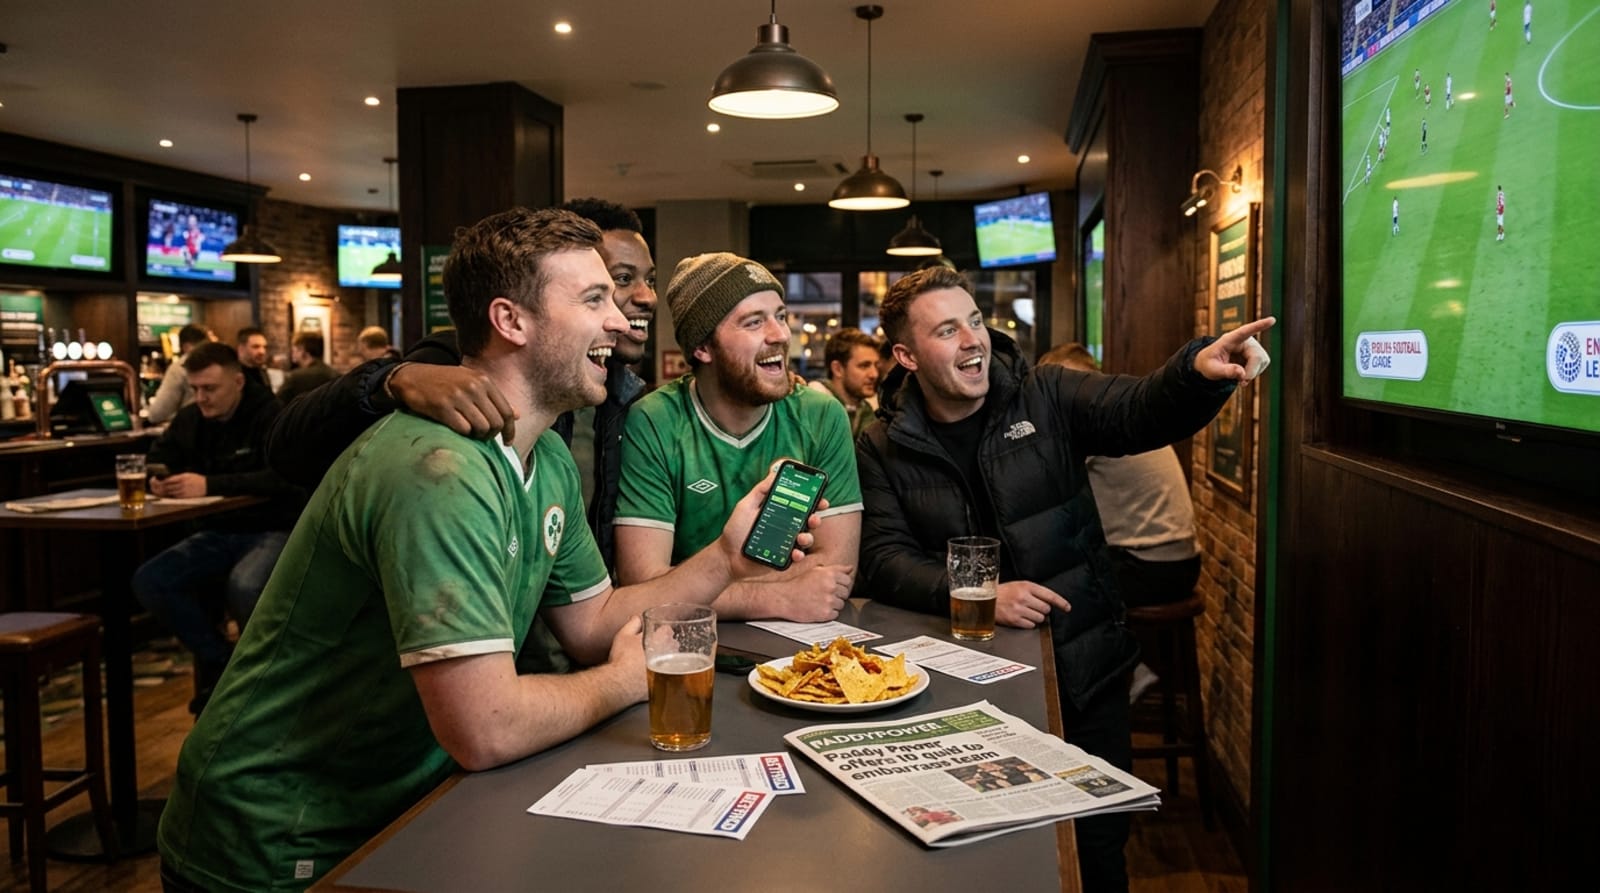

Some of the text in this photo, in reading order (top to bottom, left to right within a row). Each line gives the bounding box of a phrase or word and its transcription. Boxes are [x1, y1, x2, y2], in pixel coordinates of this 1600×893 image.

[1586, 360, 1600, 378] LE
[823, 747, 884, 763] Paddy
[839, 756, 896, 772] offers
[921, 745, 963, 761] quid
[851, 751, 1001, 781] embarrass team
